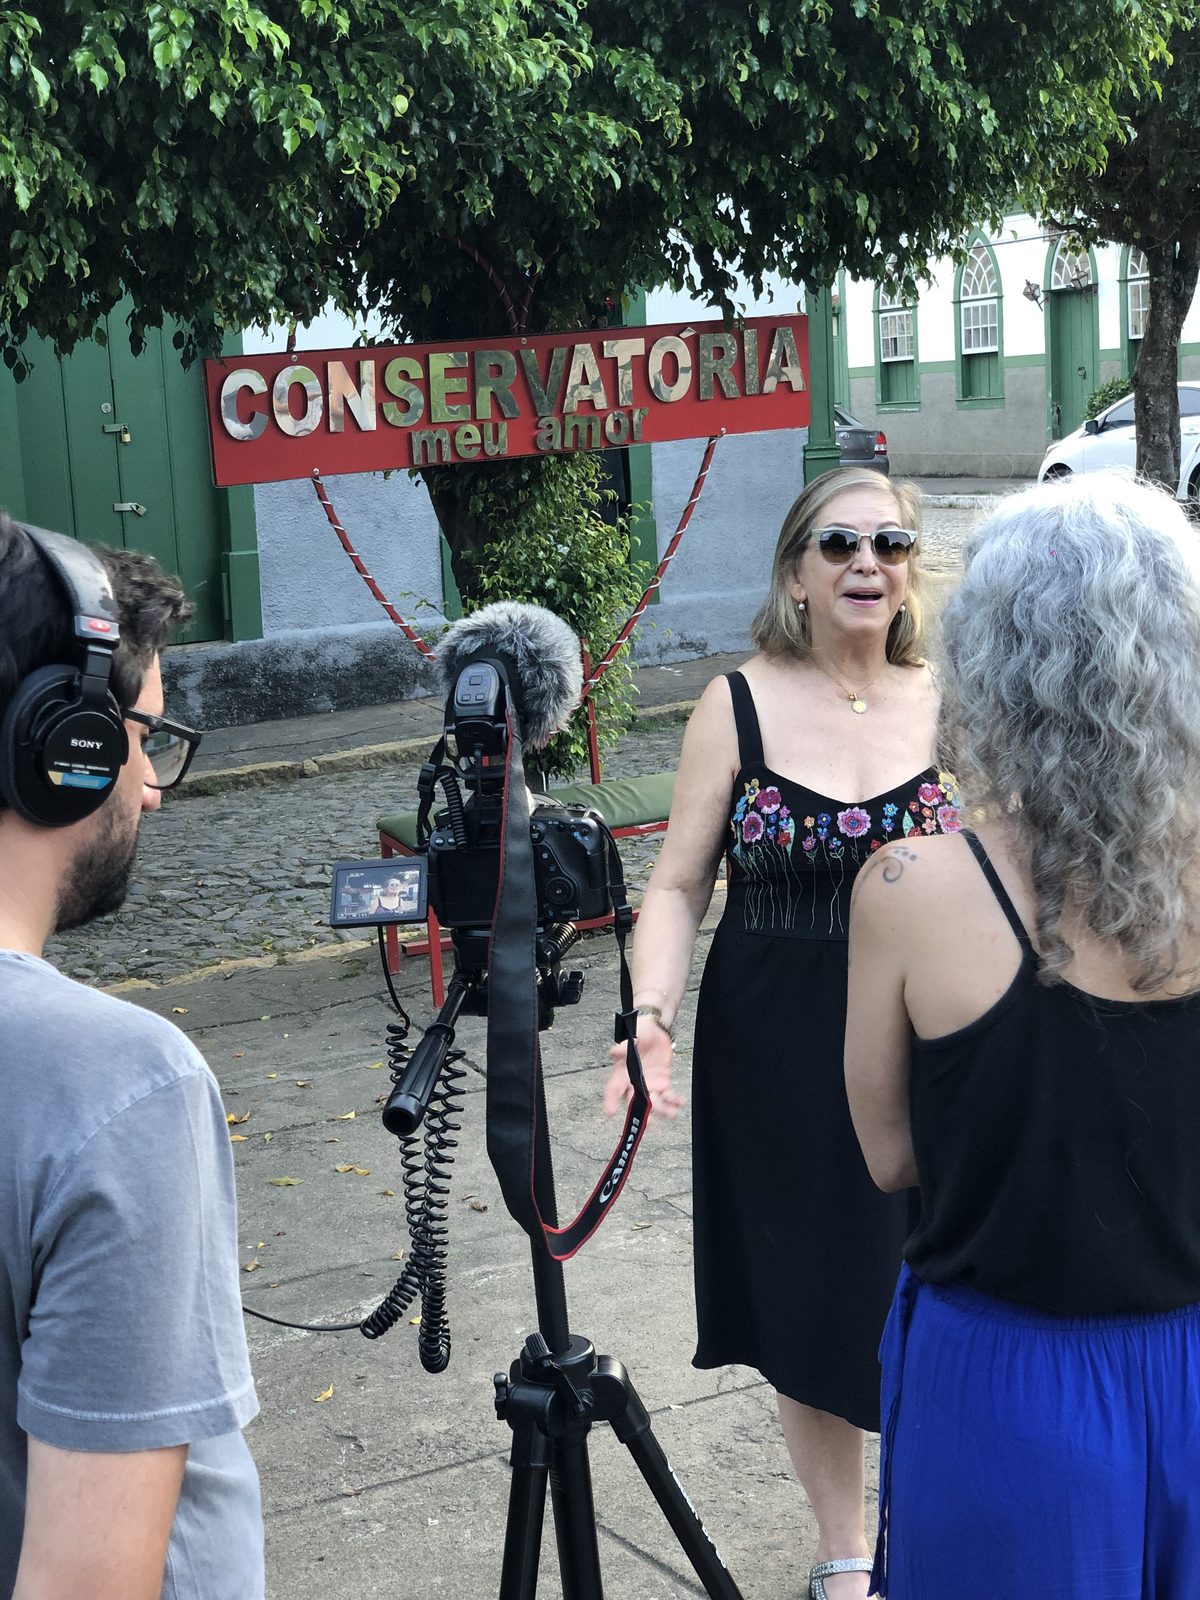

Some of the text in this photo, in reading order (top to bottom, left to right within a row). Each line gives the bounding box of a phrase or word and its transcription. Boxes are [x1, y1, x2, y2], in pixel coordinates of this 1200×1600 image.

[220, 326, 807, 442] CONSERVATÓRIA
[411, 406, 649, 466] meu amor
[70, 738, 104, 750] SONY
[599, 1116, 641, 1204] Canon
